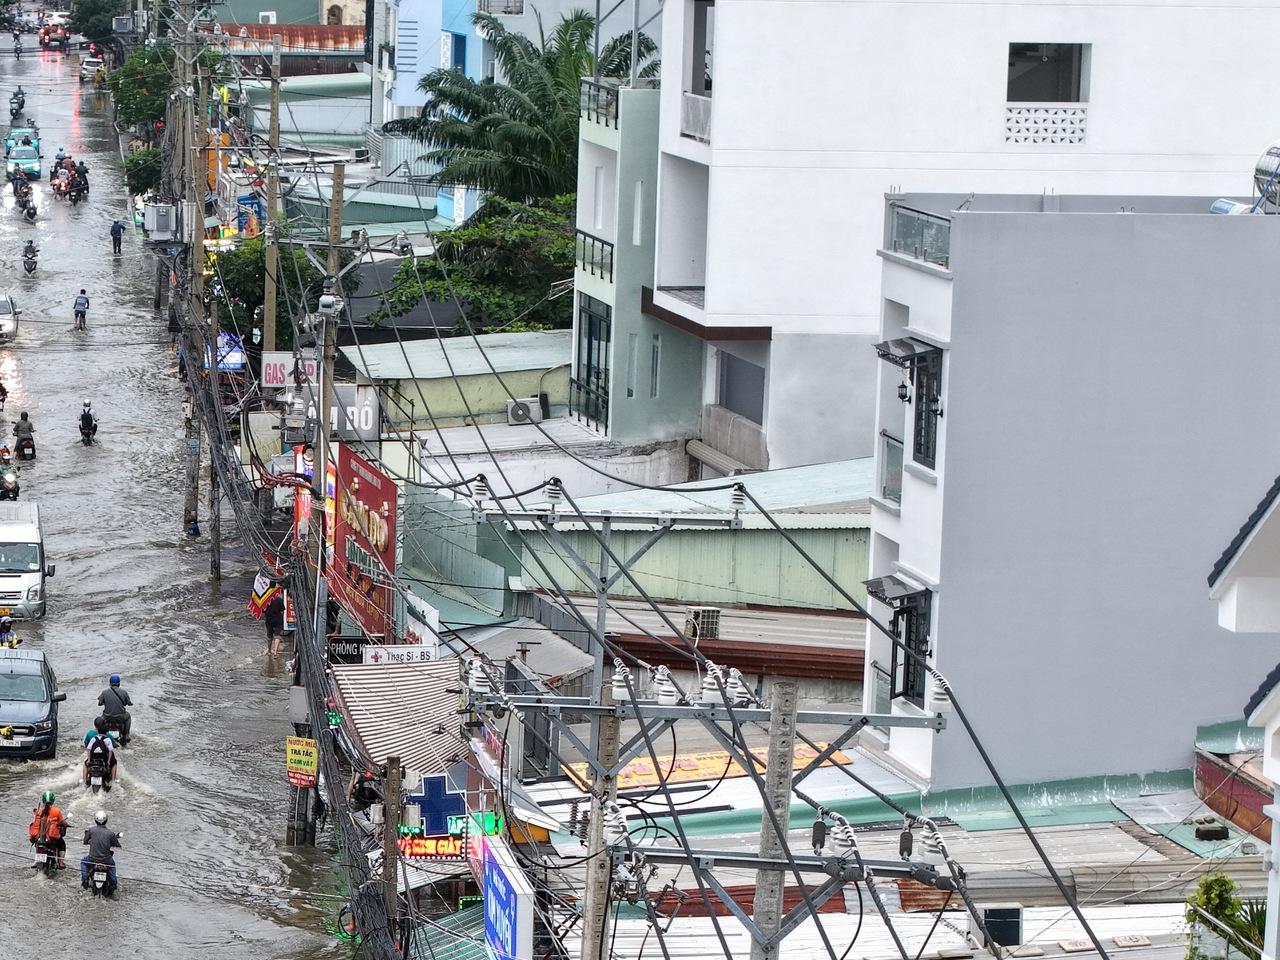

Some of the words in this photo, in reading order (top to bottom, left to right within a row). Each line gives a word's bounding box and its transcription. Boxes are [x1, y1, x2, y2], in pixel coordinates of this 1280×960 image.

[264, 363, 286, 385] GAS
[331, 640, 358, 655] PHÒNG
[420, 651, 431, 661] BS
